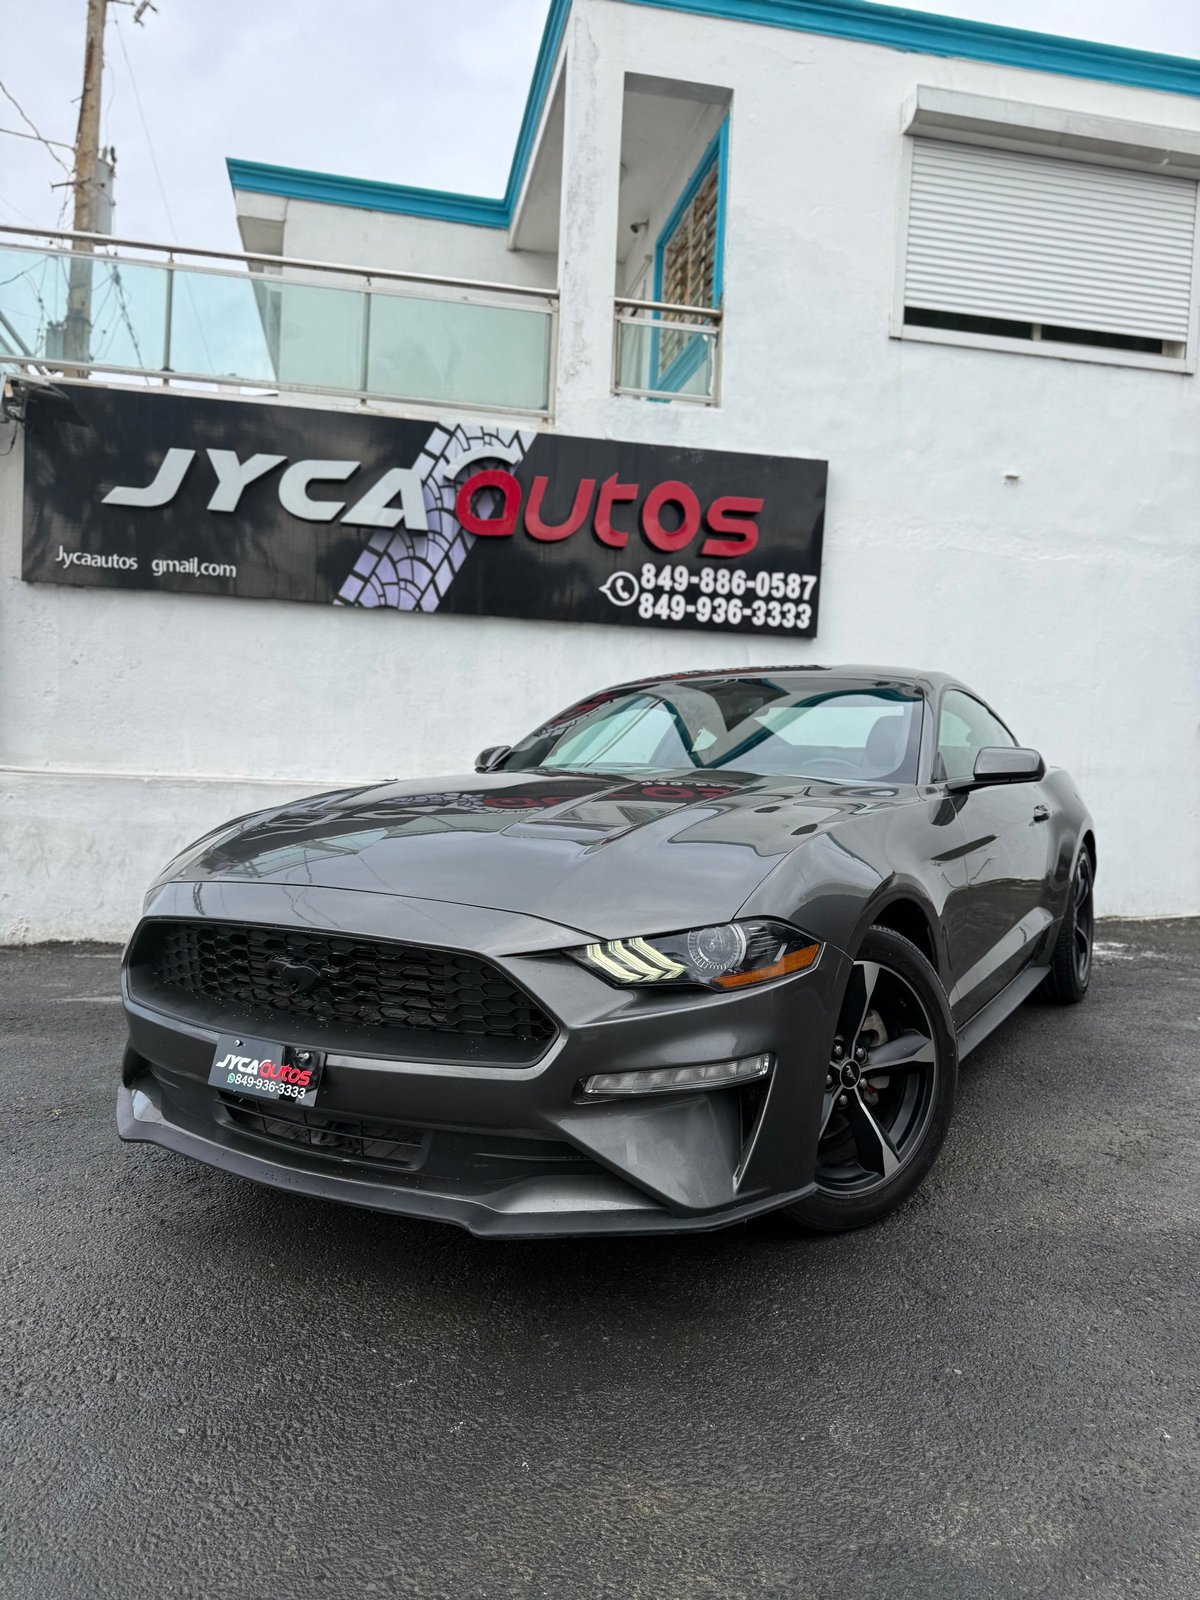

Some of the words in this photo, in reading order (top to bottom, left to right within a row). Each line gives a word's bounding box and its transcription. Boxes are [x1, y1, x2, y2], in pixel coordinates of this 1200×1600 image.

[55, 545, 138, 570] Jycaautos
[641, 563, 817, 600] 849-886-0587
[638, 593, 812, 629] 849-936-3333
[234, 1073, 306, 1099] 849-936-3333
